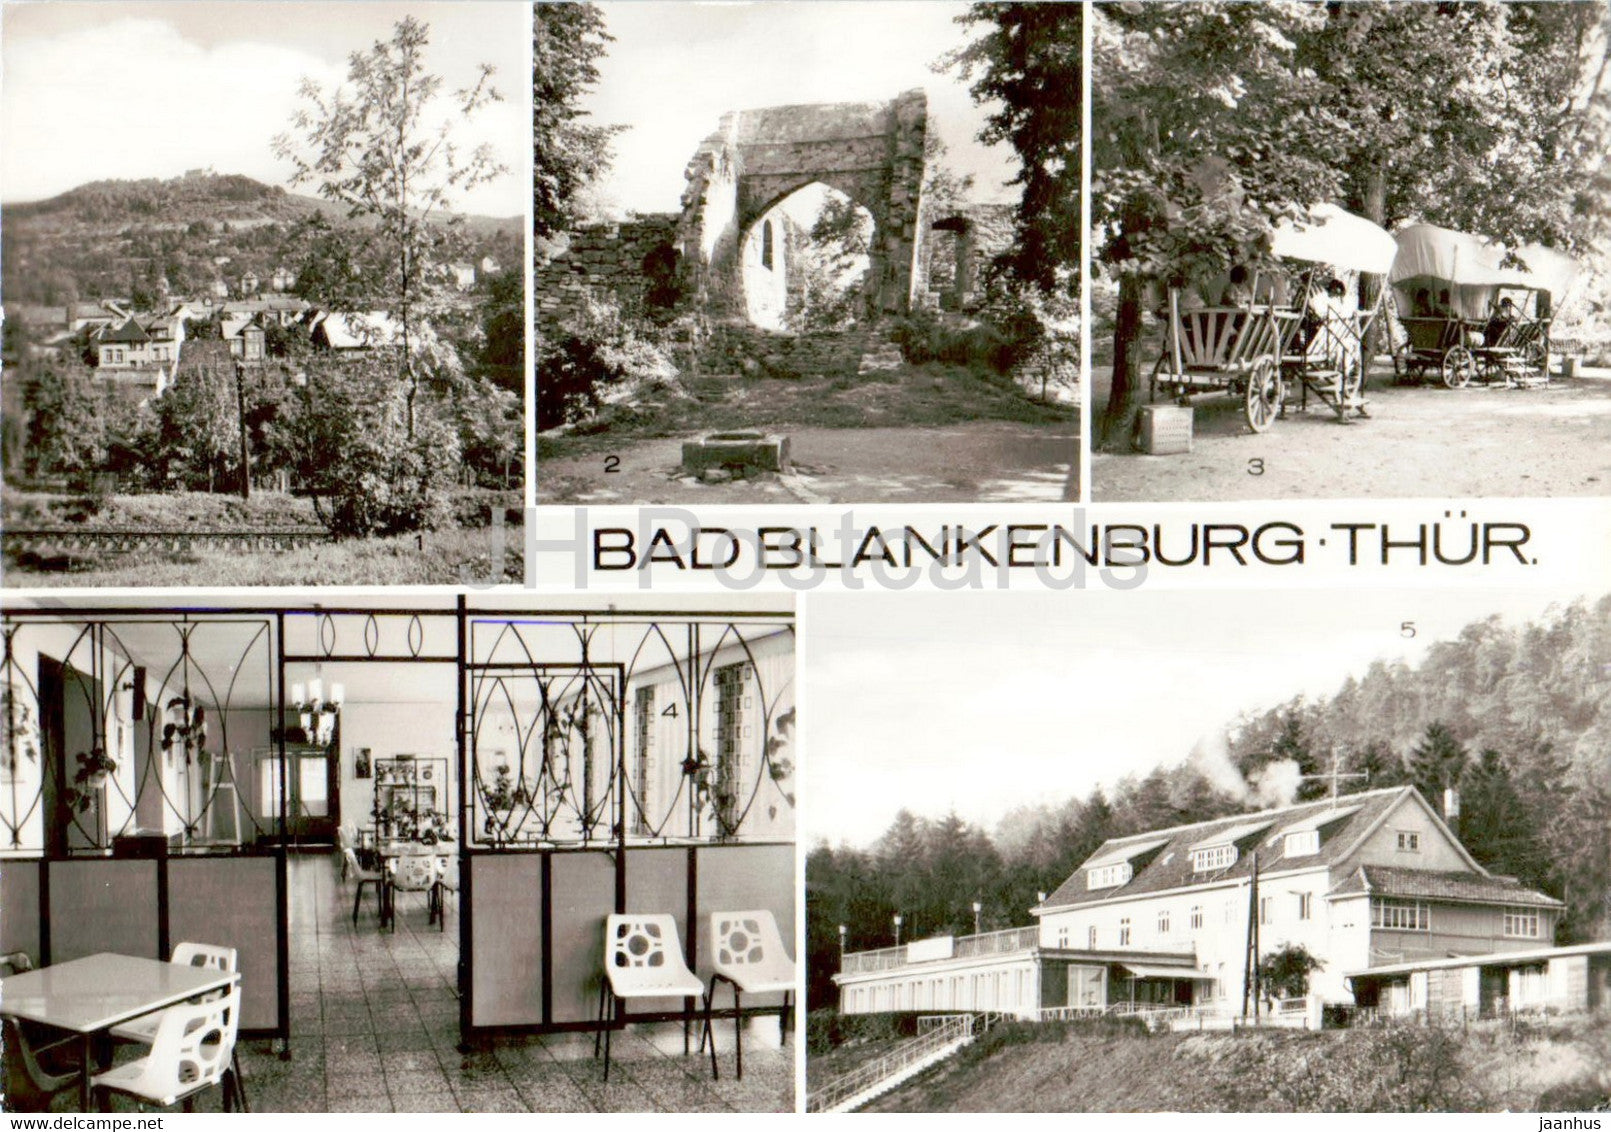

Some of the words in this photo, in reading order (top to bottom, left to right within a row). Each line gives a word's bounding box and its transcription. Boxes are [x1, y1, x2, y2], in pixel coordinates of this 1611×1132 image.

[604, 455, 620, 473] 2
[1247, 458, 1265, 475] 3
[414, 535, 423, 551] 1
[593, 526, 740, 571] BAD
[757, 521, 1304, 569] BLANKENBURG
[1330, 510, 1538, 566] THÜR.
[1400, 622, 1417, 638] 5
[661, 702, 679, 719] 4
